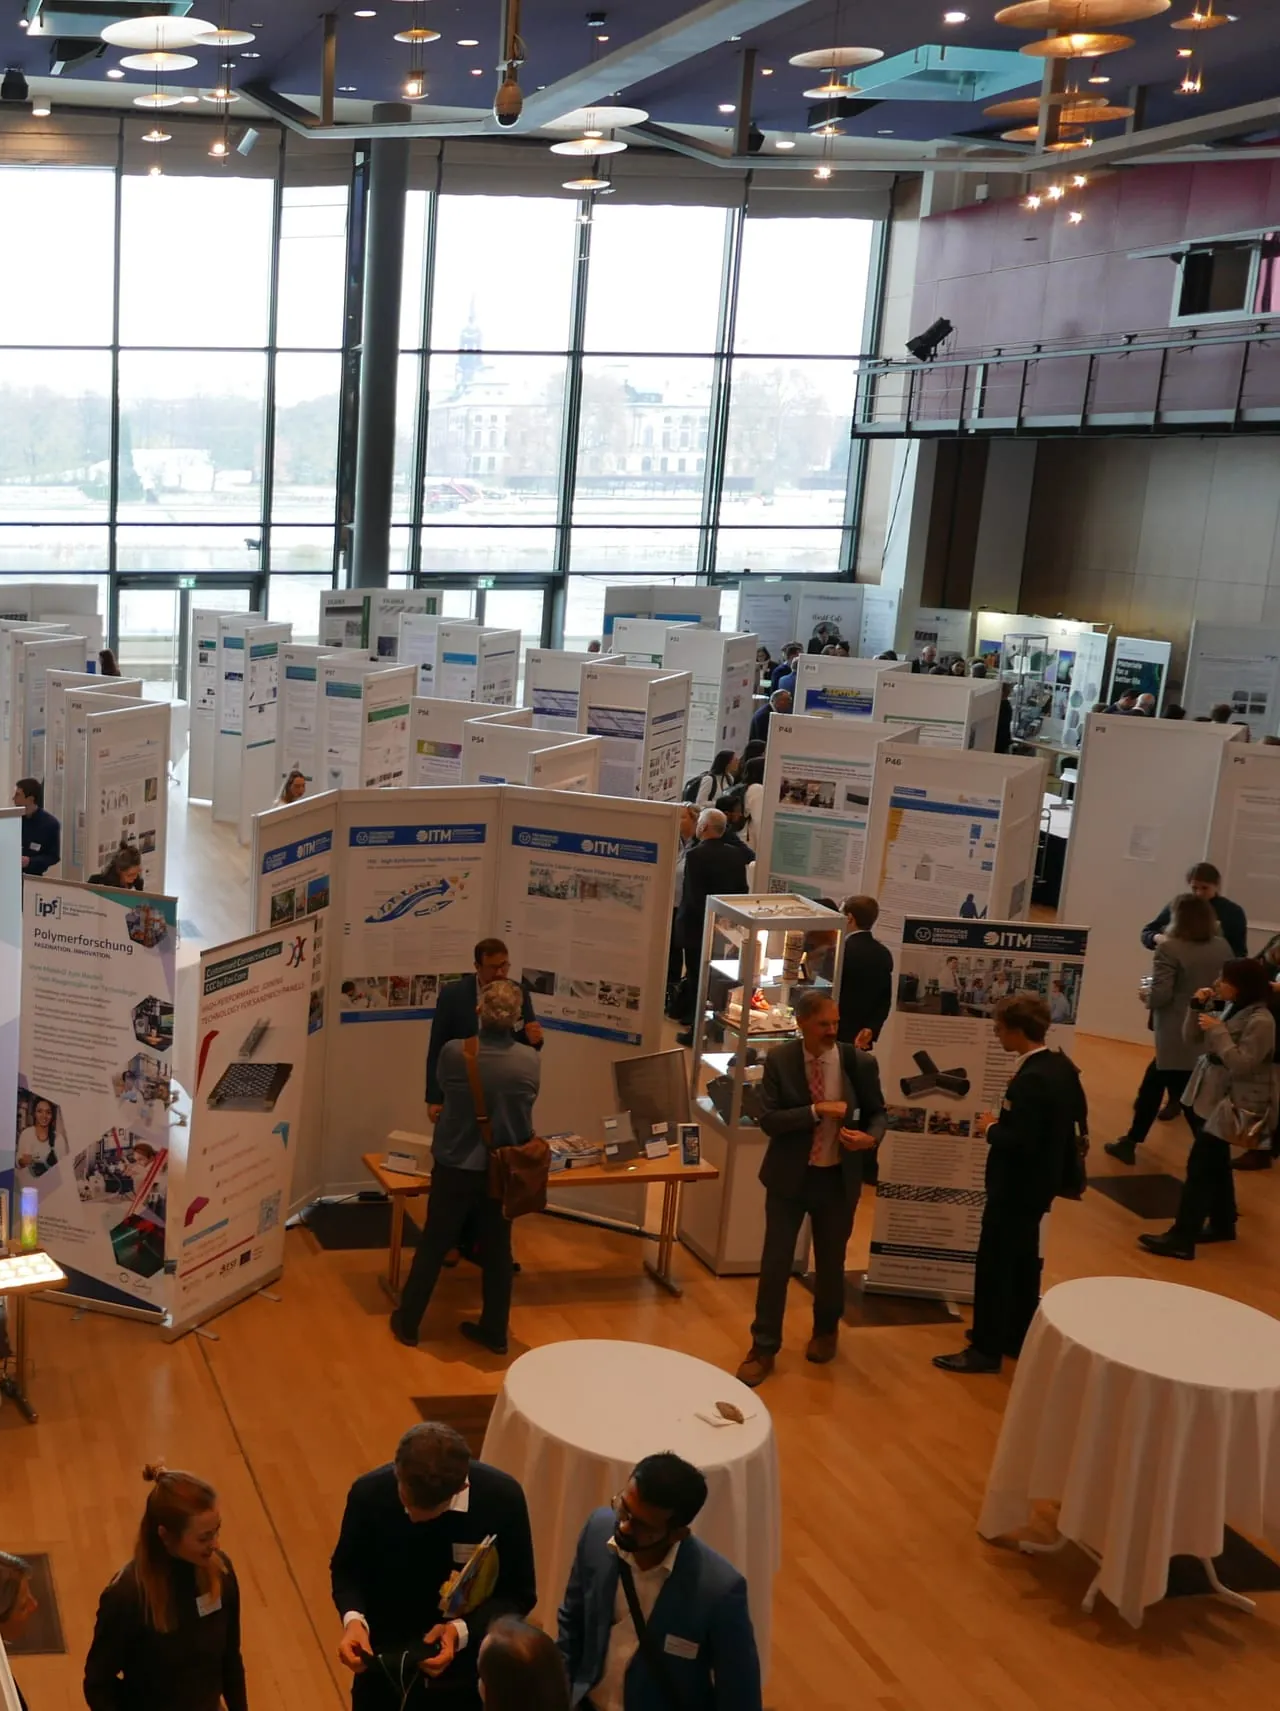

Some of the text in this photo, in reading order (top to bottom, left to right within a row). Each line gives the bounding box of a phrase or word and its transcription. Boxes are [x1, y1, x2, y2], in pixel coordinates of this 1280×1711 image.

[472, 735, 484, 743] P54
[885, 756, 902, 766] P46
[428, 829, 452, 843] ITM
[594, 840, 620, 856] ITM
[34, 928, 134, 955] Polymerforschung
[1000, 932, 1032, 948] ITM
